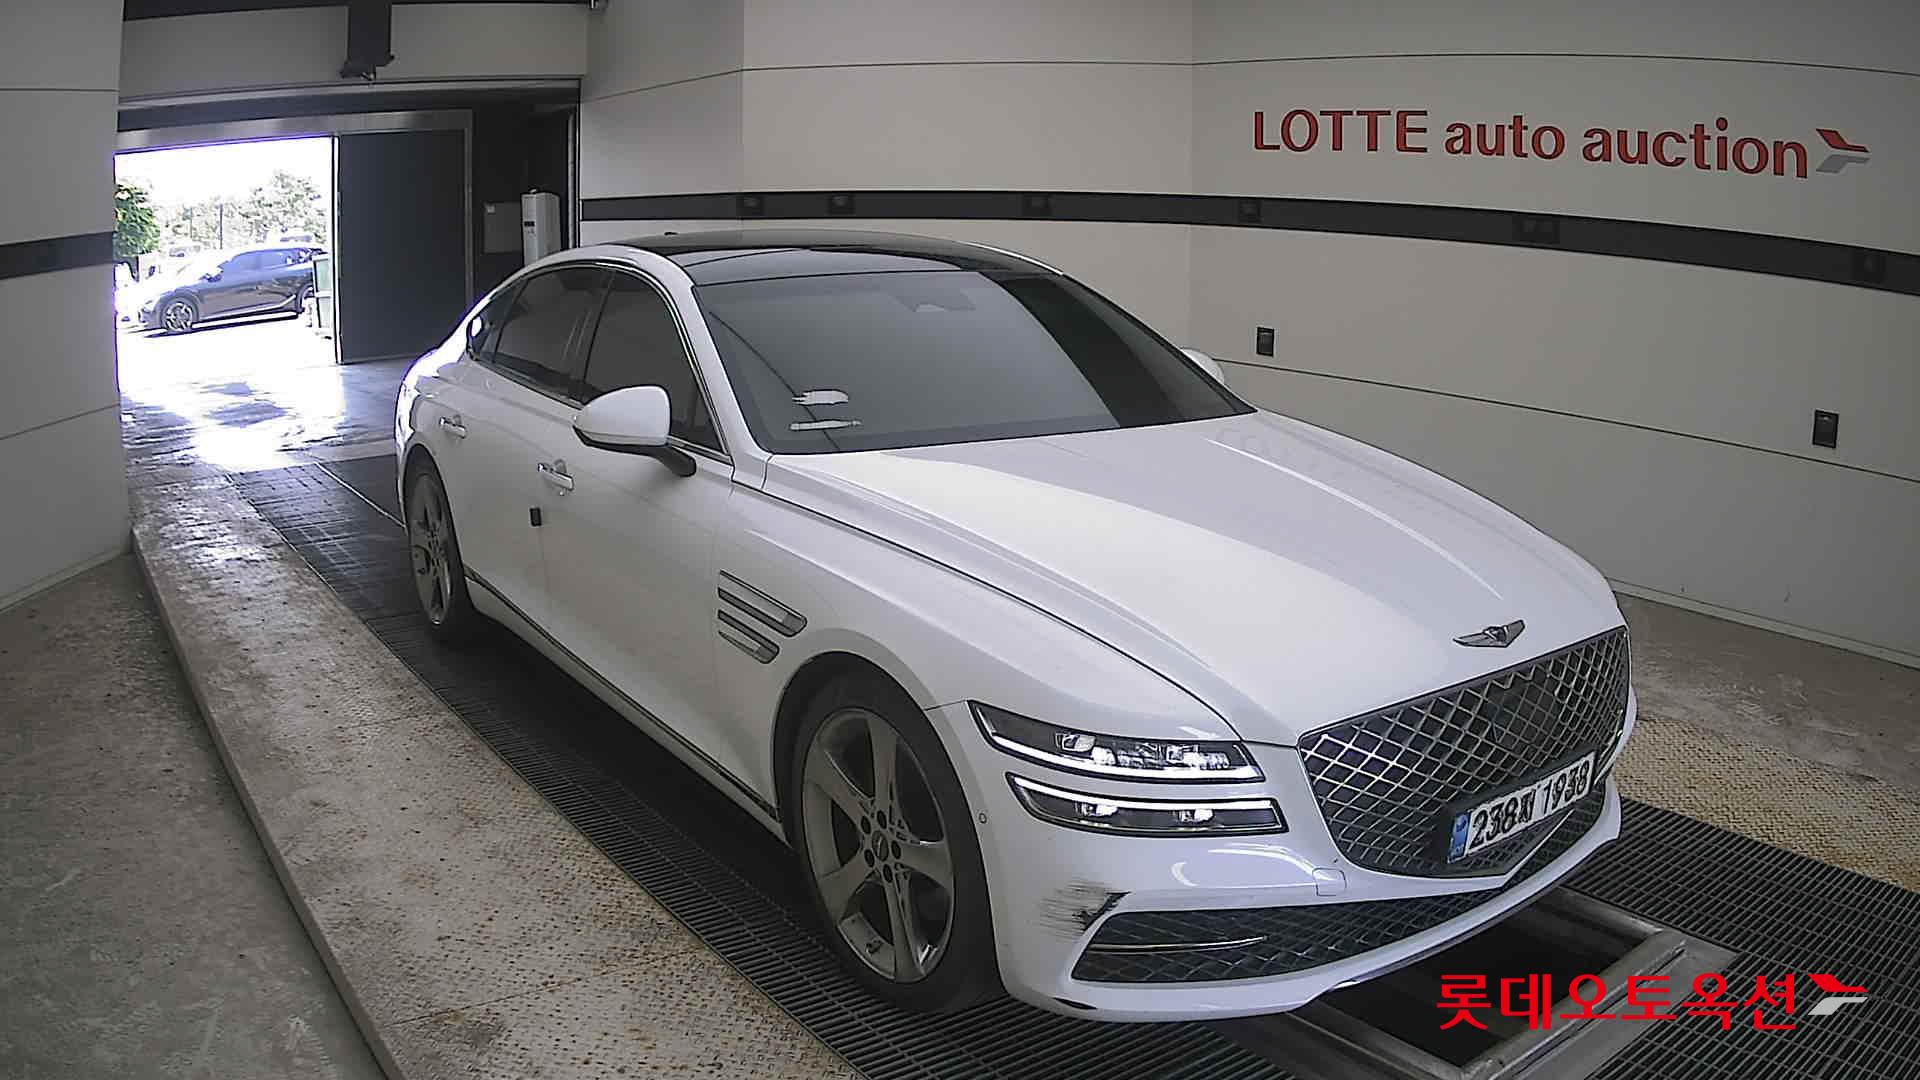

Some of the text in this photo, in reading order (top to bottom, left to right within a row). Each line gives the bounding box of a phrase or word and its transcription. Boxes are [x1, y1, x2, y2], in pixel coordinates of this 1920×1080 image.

[1253, 110, 1808, 178] LOTTE auto auction
[1542, 760, 1590, 815] 1938
